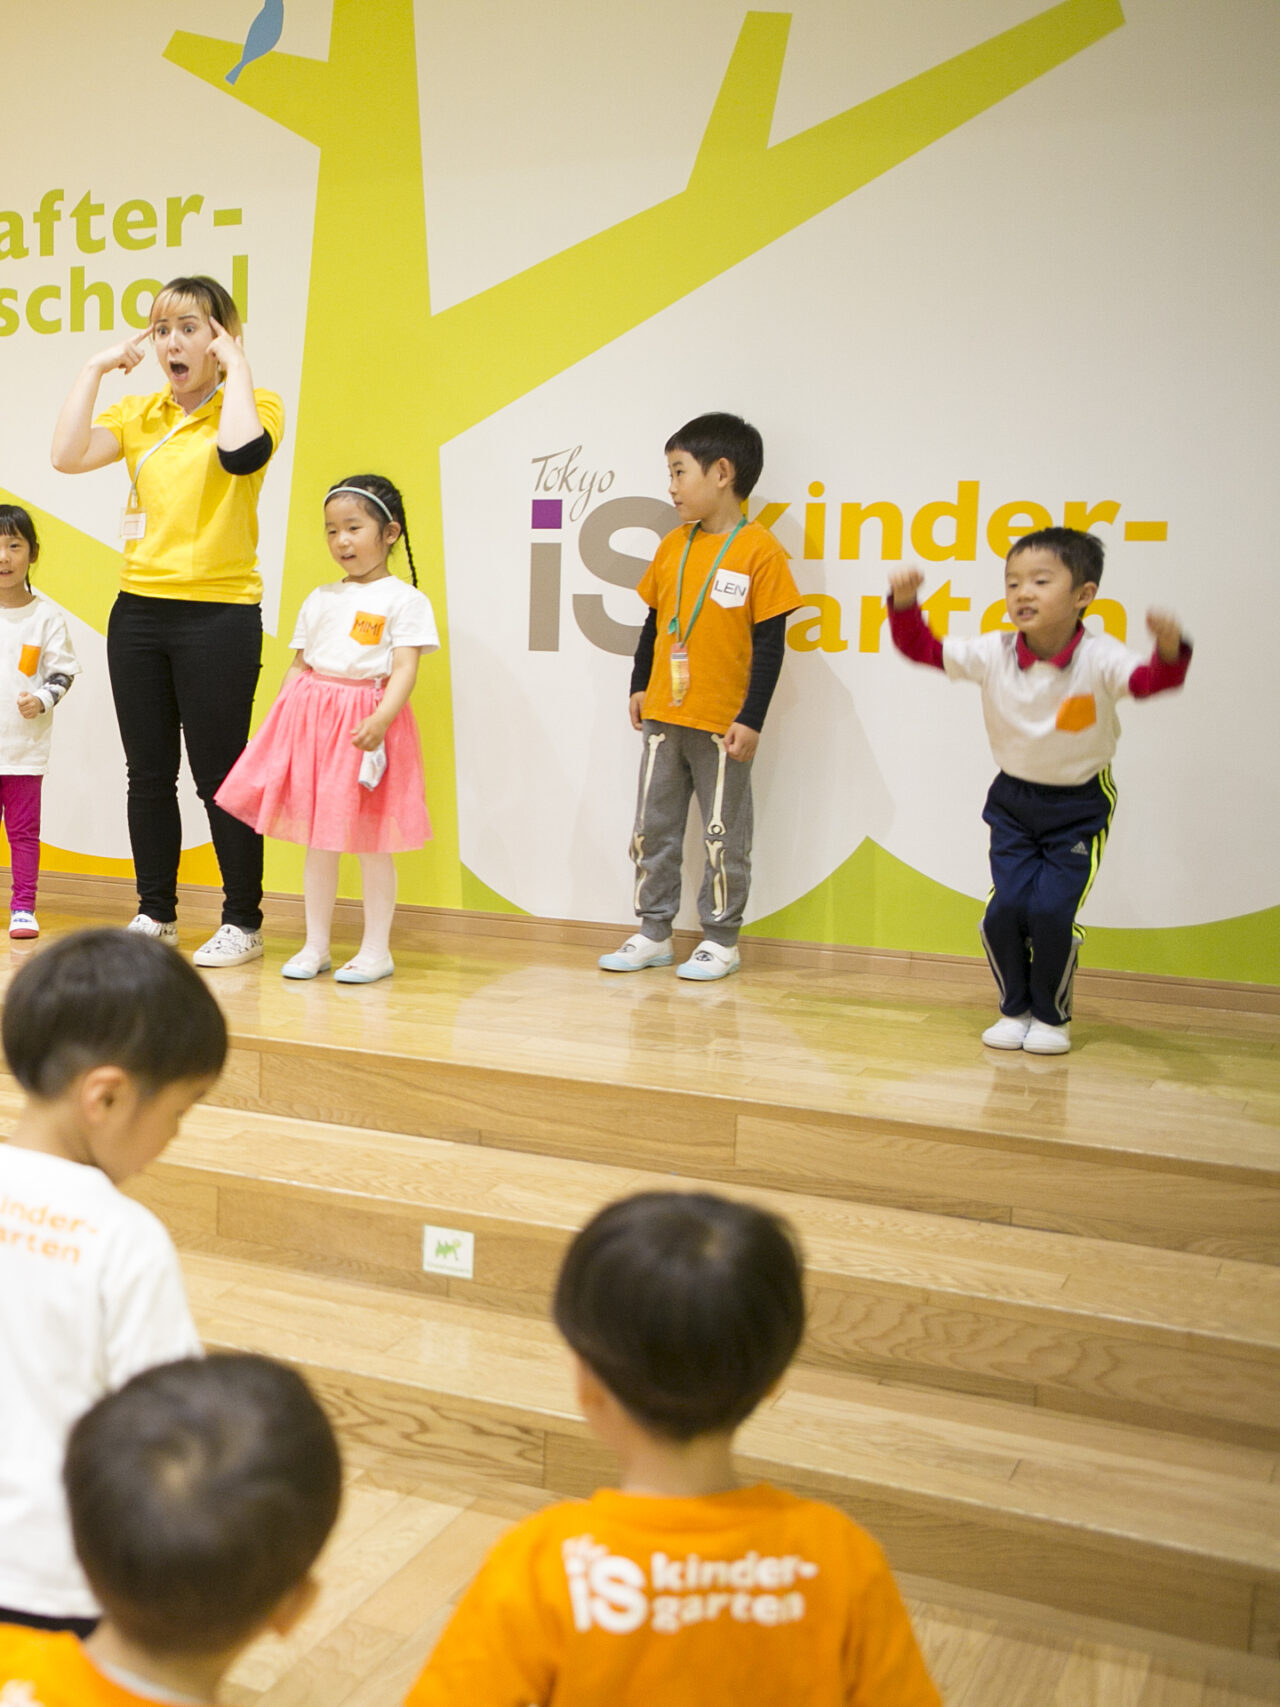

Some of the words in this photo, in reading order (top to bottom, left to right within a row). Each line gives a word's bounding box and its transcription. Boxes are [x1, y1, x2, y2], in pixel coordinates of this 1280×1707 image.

[531, 445, 615, 522] Tokyo
[714, 580, 746, 597] LEN
[566, 1554, 648, 1635] iS
[651, 1551, 818, 1592] kinder-
[651, 1591, 805, 1635] garten
